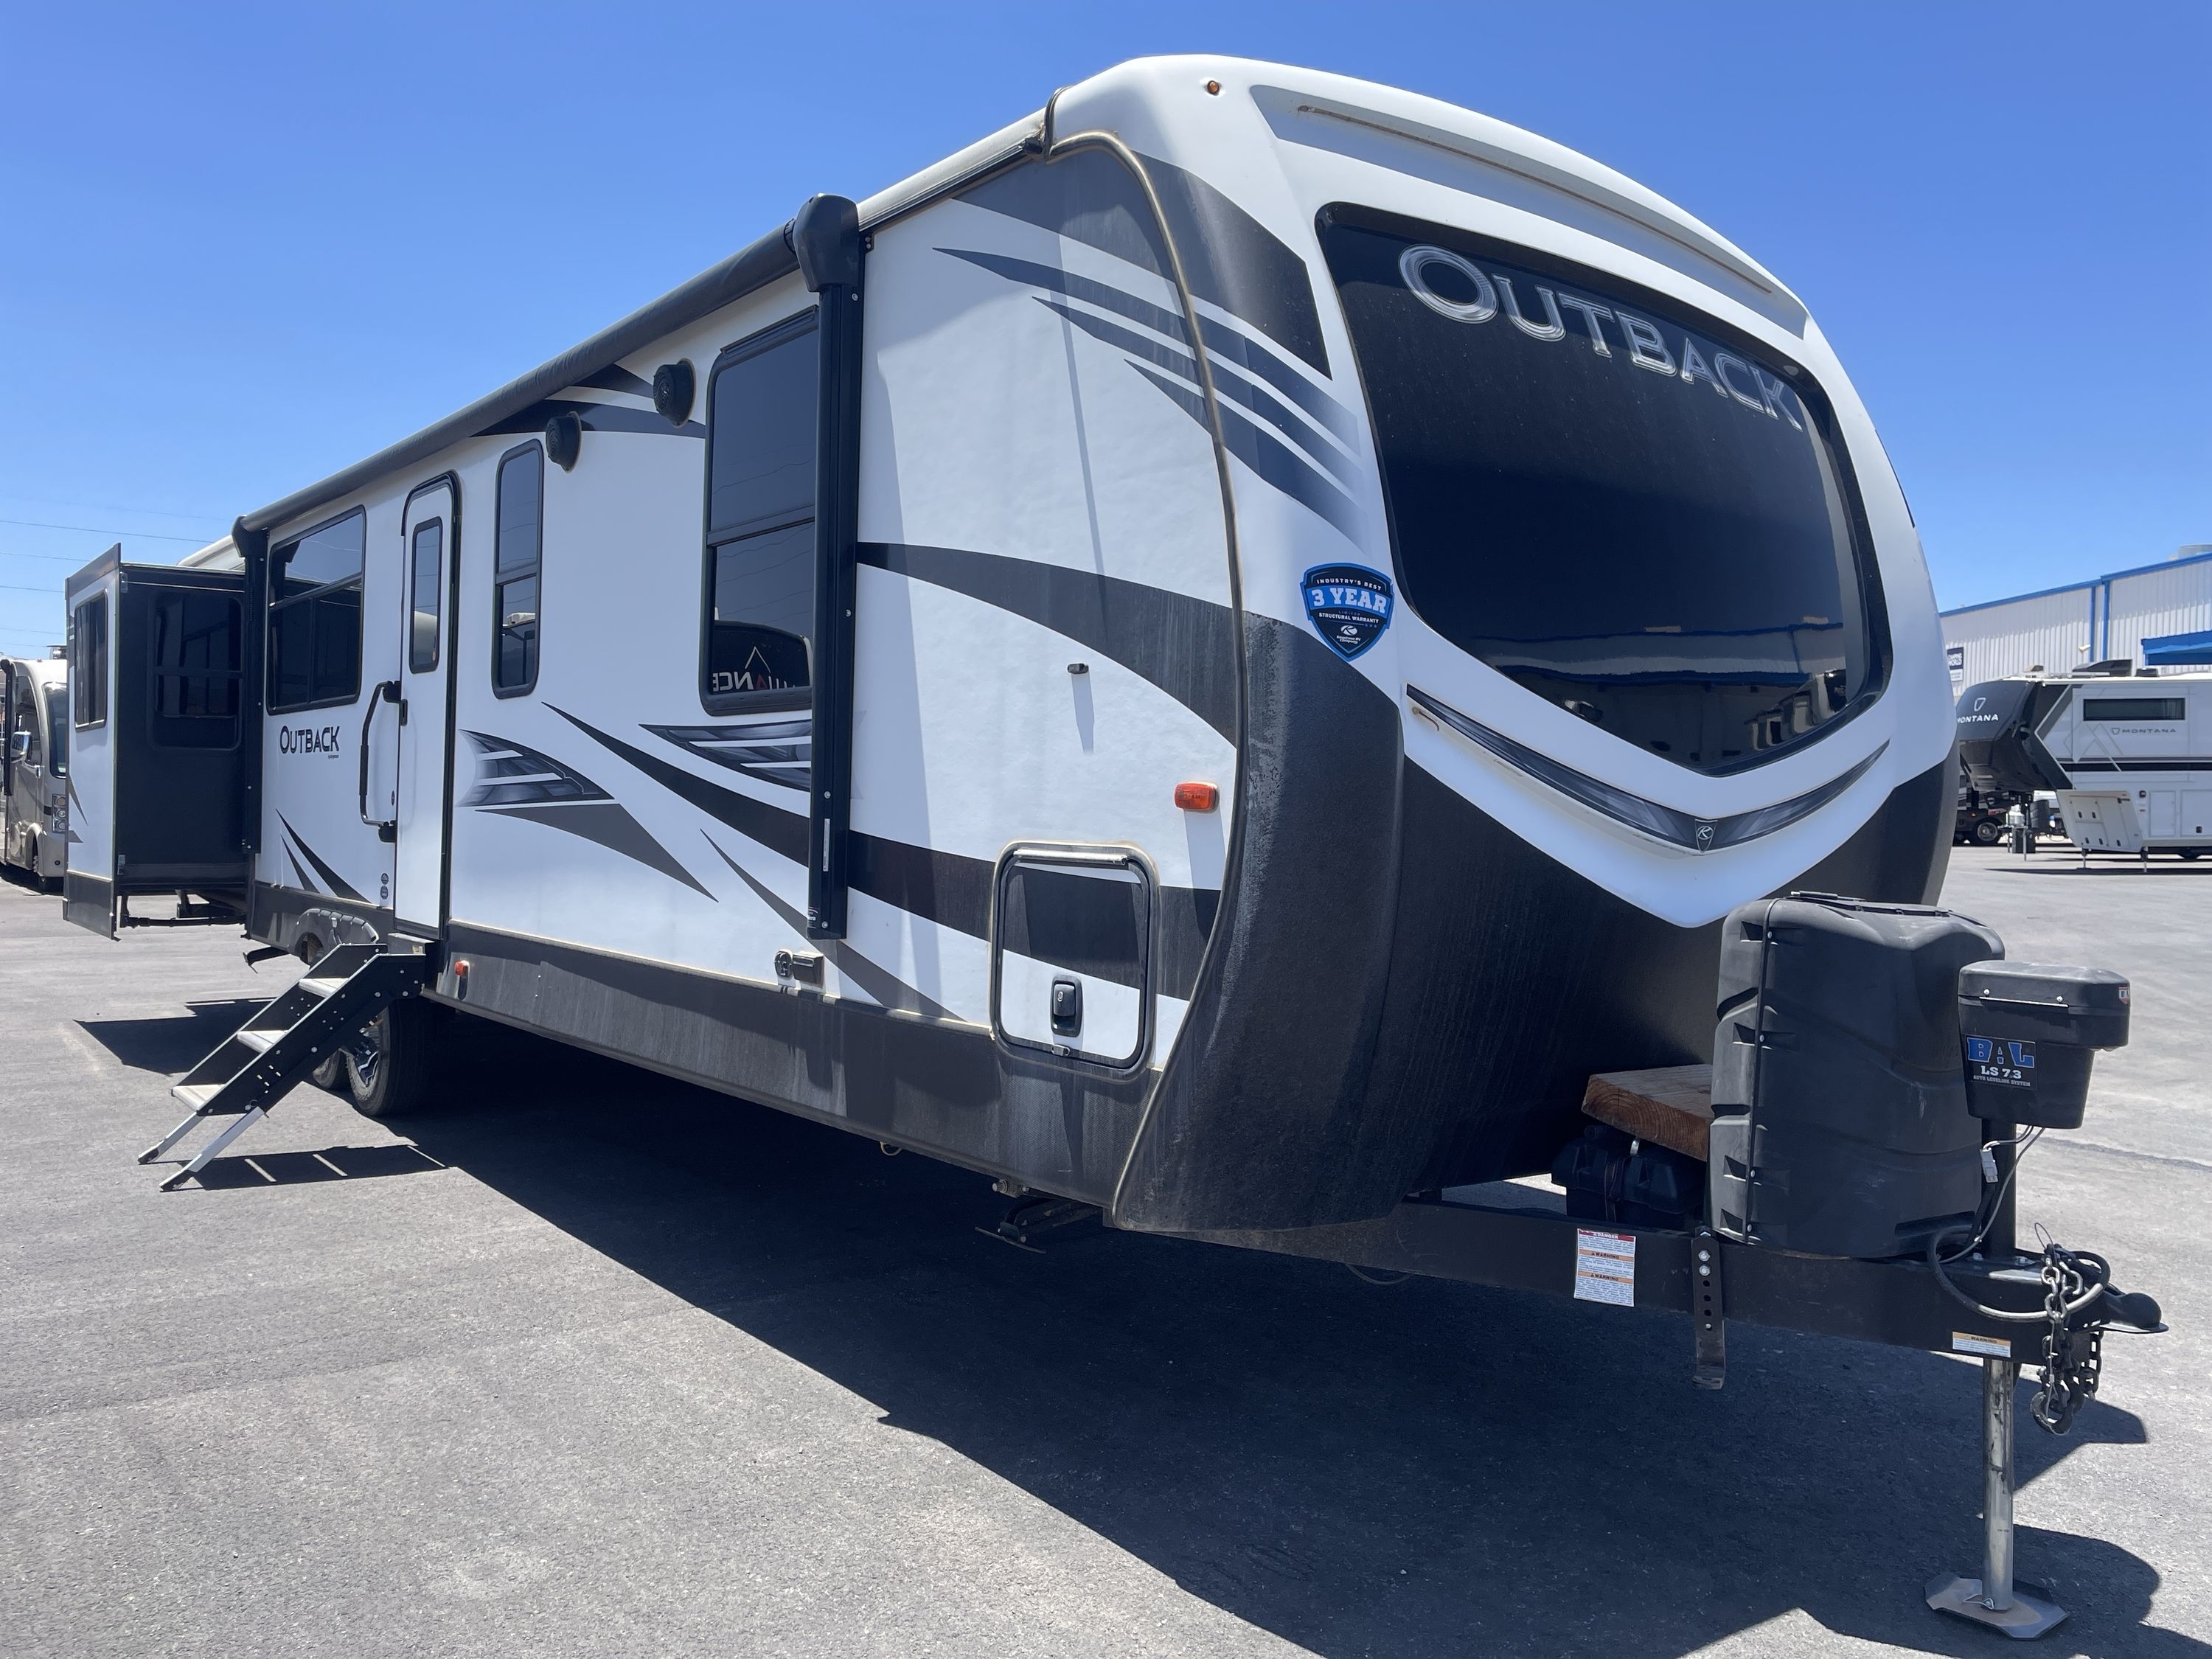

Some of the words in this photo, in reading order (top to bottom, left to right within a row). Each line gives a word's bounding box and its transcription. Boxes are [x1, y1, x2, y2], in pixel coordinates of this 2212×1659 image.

[1399, 243, 1804, 432] OUTBACK
[1364, 581, 1382, 591] BEST
[1312, 589, 1325, 606] 3
[1330, 588, 1386, 613] YEAR
[1318, 612, 1351, 620] STRUCTURAL
[280, 726, 341, 754] OUTBACK
[1980, 1065, 1999, 1077] LS
